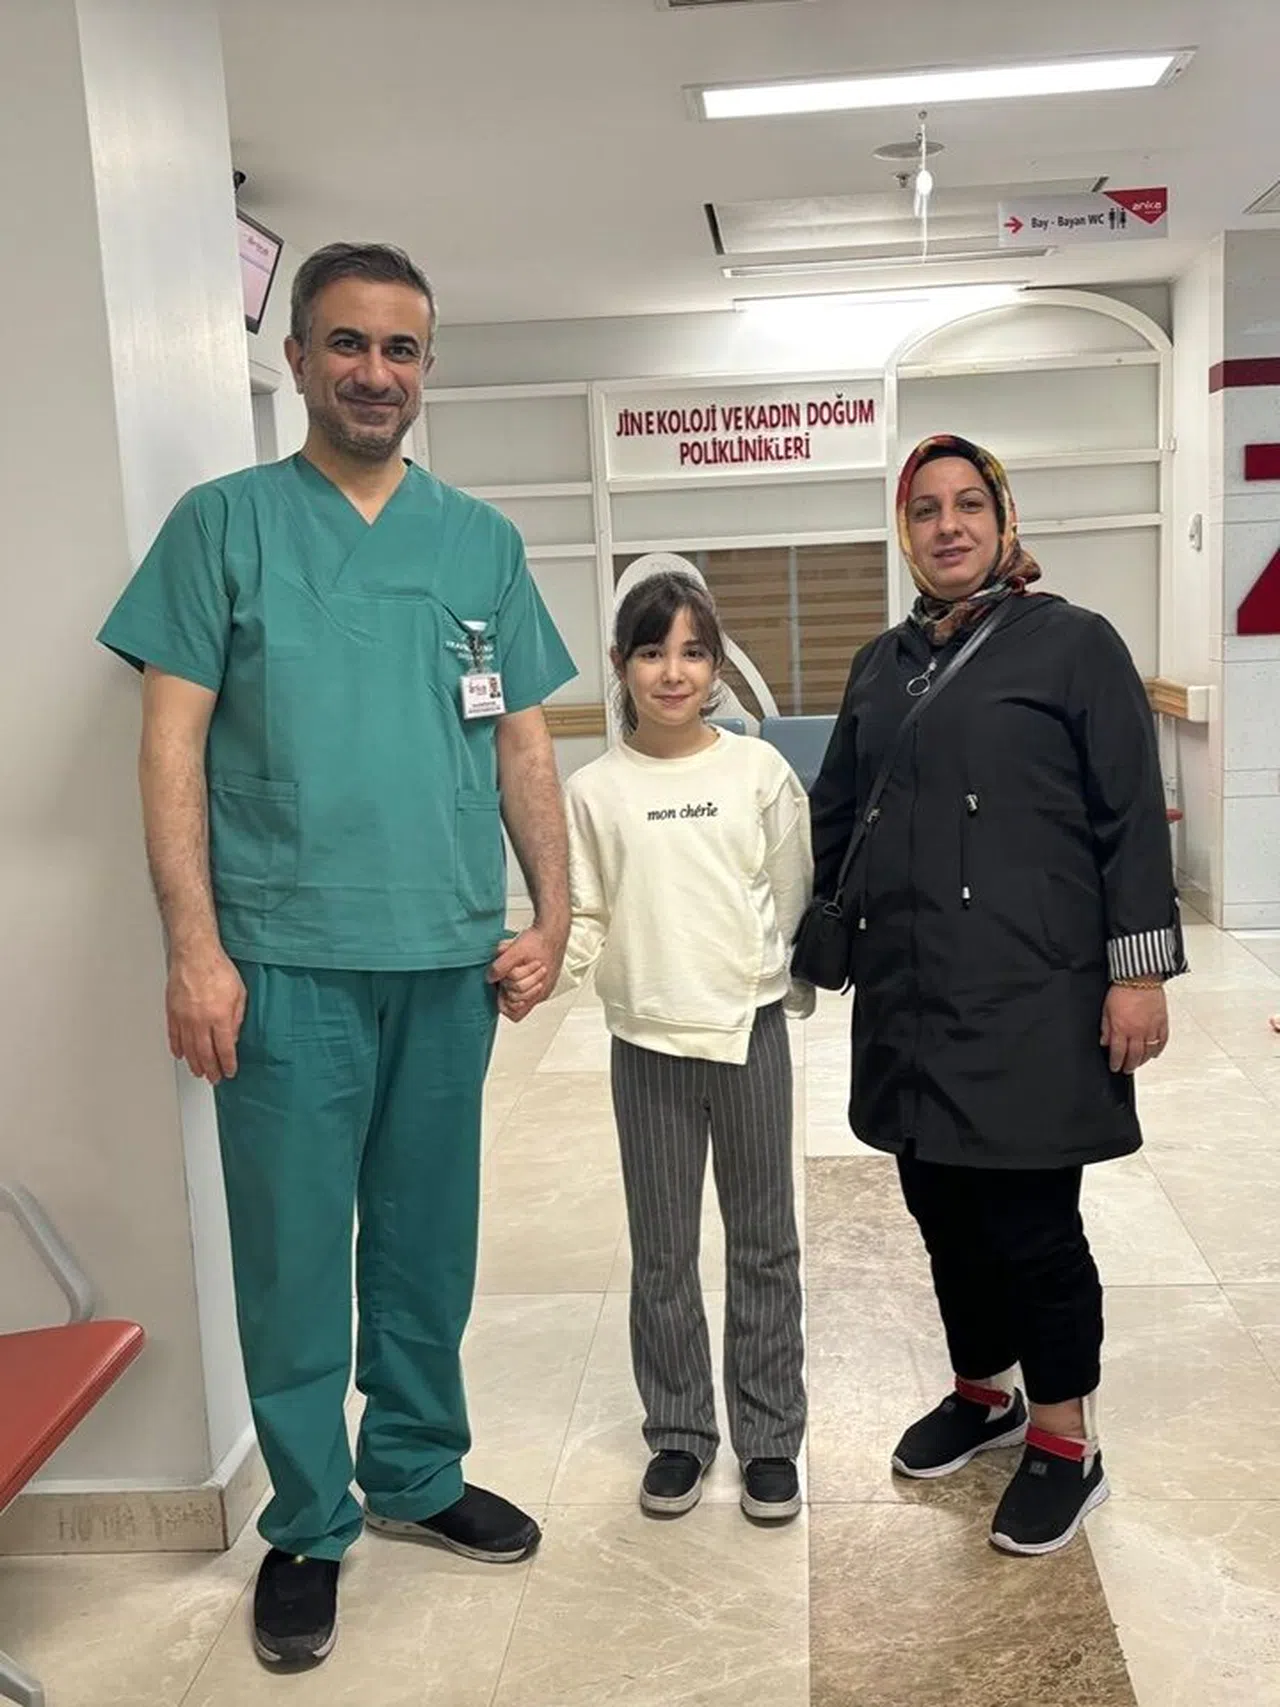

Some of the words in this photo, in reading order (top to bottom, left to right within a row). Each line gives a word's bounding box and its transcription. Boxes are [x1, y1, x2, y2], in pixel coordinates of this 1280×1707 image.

[1031, 217, 1048, 229] Bay
[1057, 216, 1086, 228] Bayan
[1088, 214, 1104, 225] WC
[806, 393, 875, 425] DOĞUM
[647, 808, 677, 820] mon
